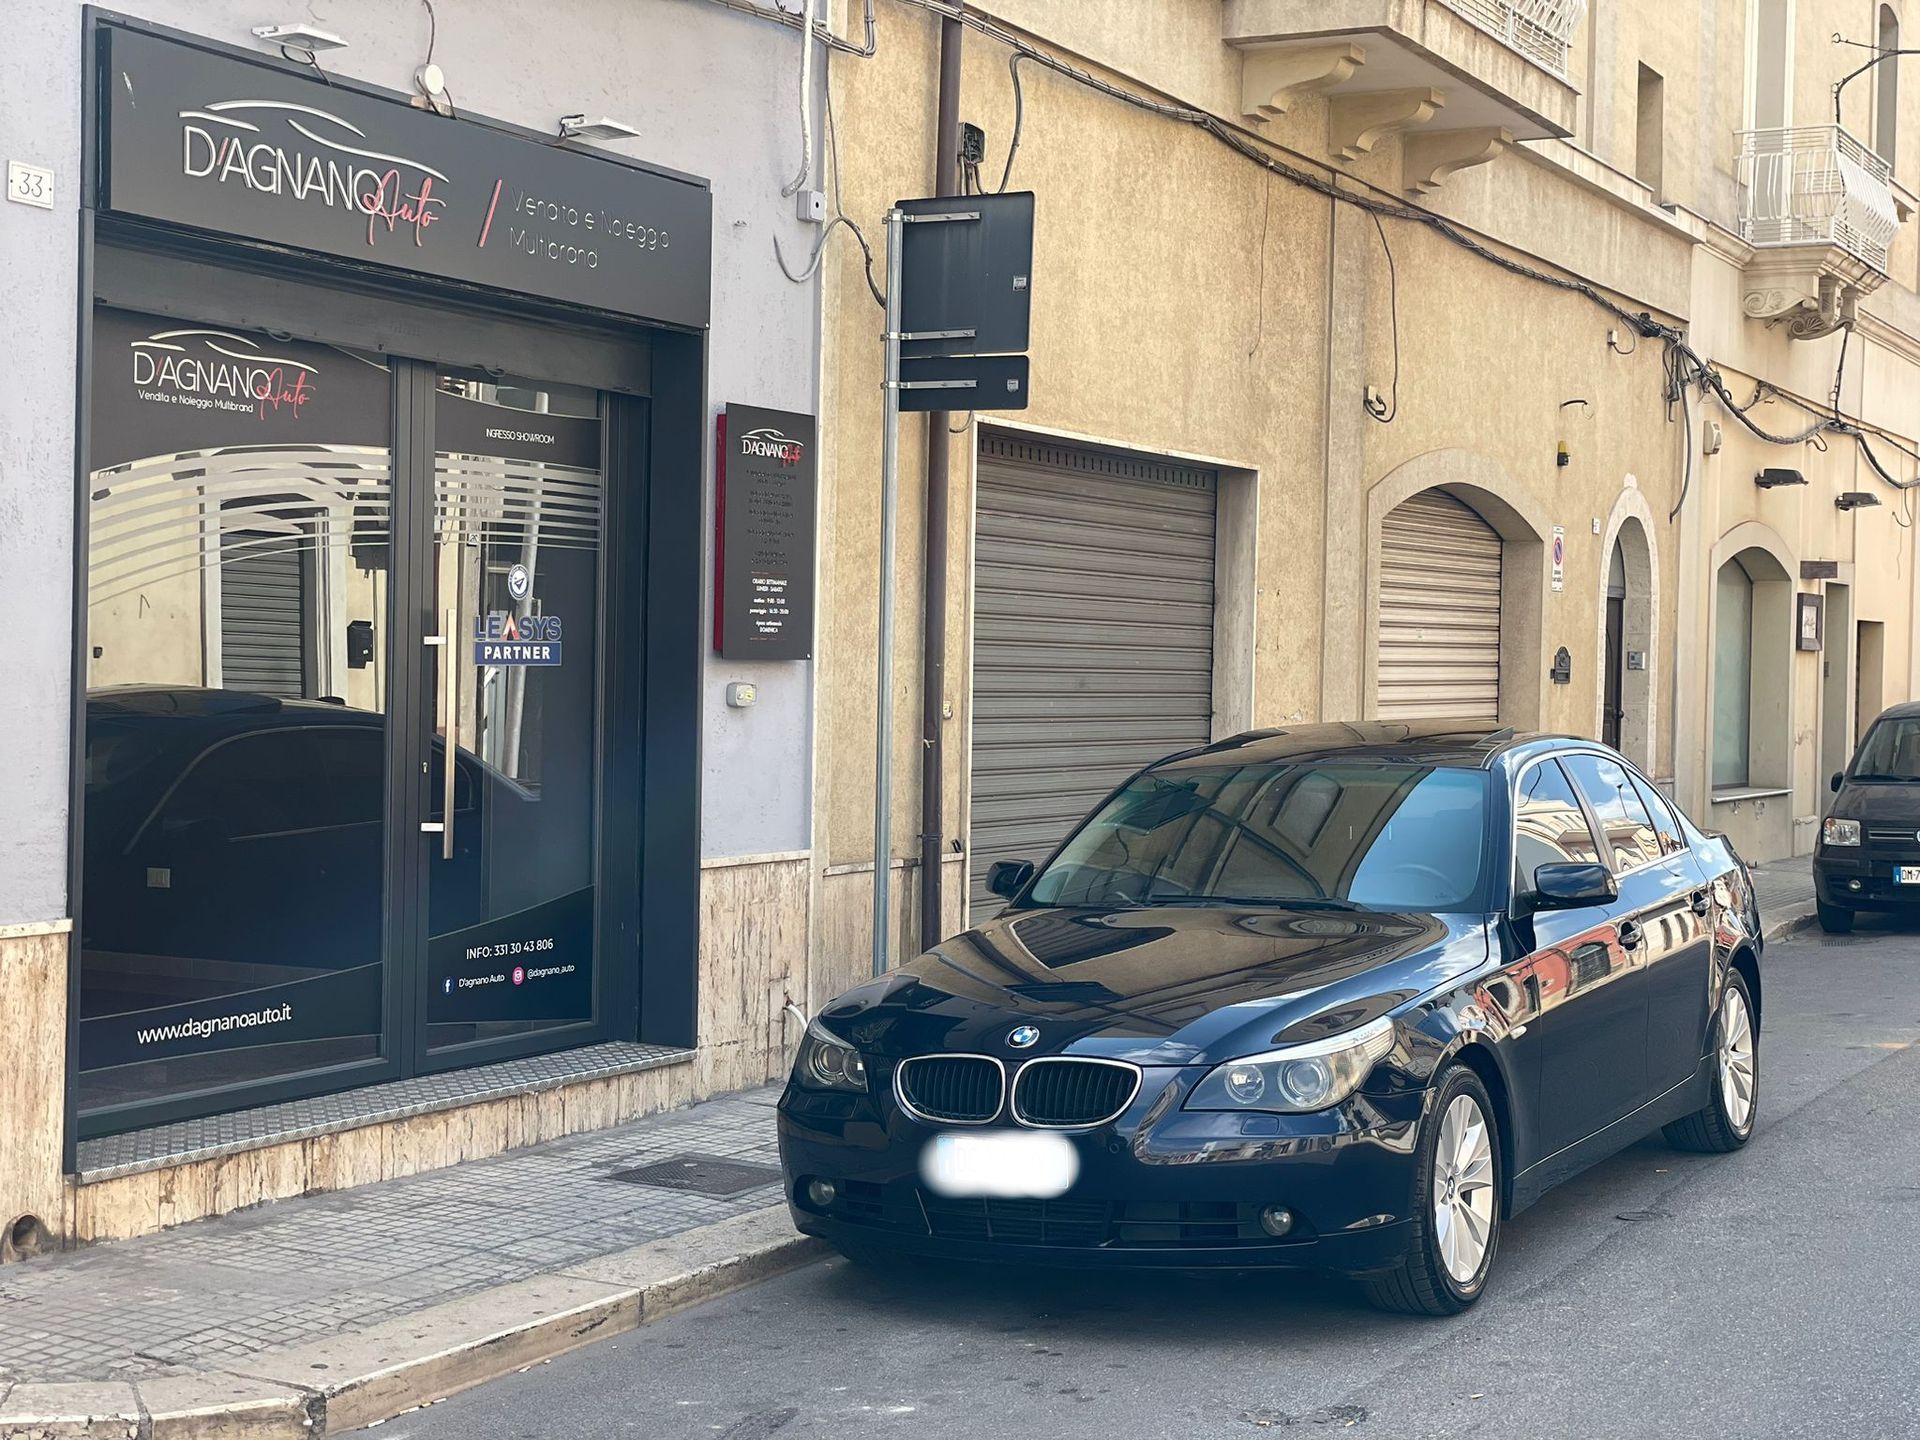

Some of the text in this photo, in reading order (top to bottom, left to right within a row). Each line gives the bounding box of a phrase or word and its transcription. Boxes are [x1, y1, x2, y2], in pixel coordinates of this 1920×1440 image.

[19, 171, 43, 198] 33
[183, 125, 447, 247] D'AGNANO Auto
[584, 212, 595, 230] e
[133, 351, 316, 421] D'AGNANO Auto
[138, 389, 254, 413] Vendita e Noleggio Multibrand
[486, 428, 555, 445] INGRESSO SHOWROOM
[473, 611, 562, 641] LEASYS
[484, 646, 551, 660] PARTNER
[466, 938, 554, 960] INFO: 331 30 43 806
[458, 974, 505, 989] D'agnano Auto
[137, 1003, 292, 1045] www.dagnanoauto.it
